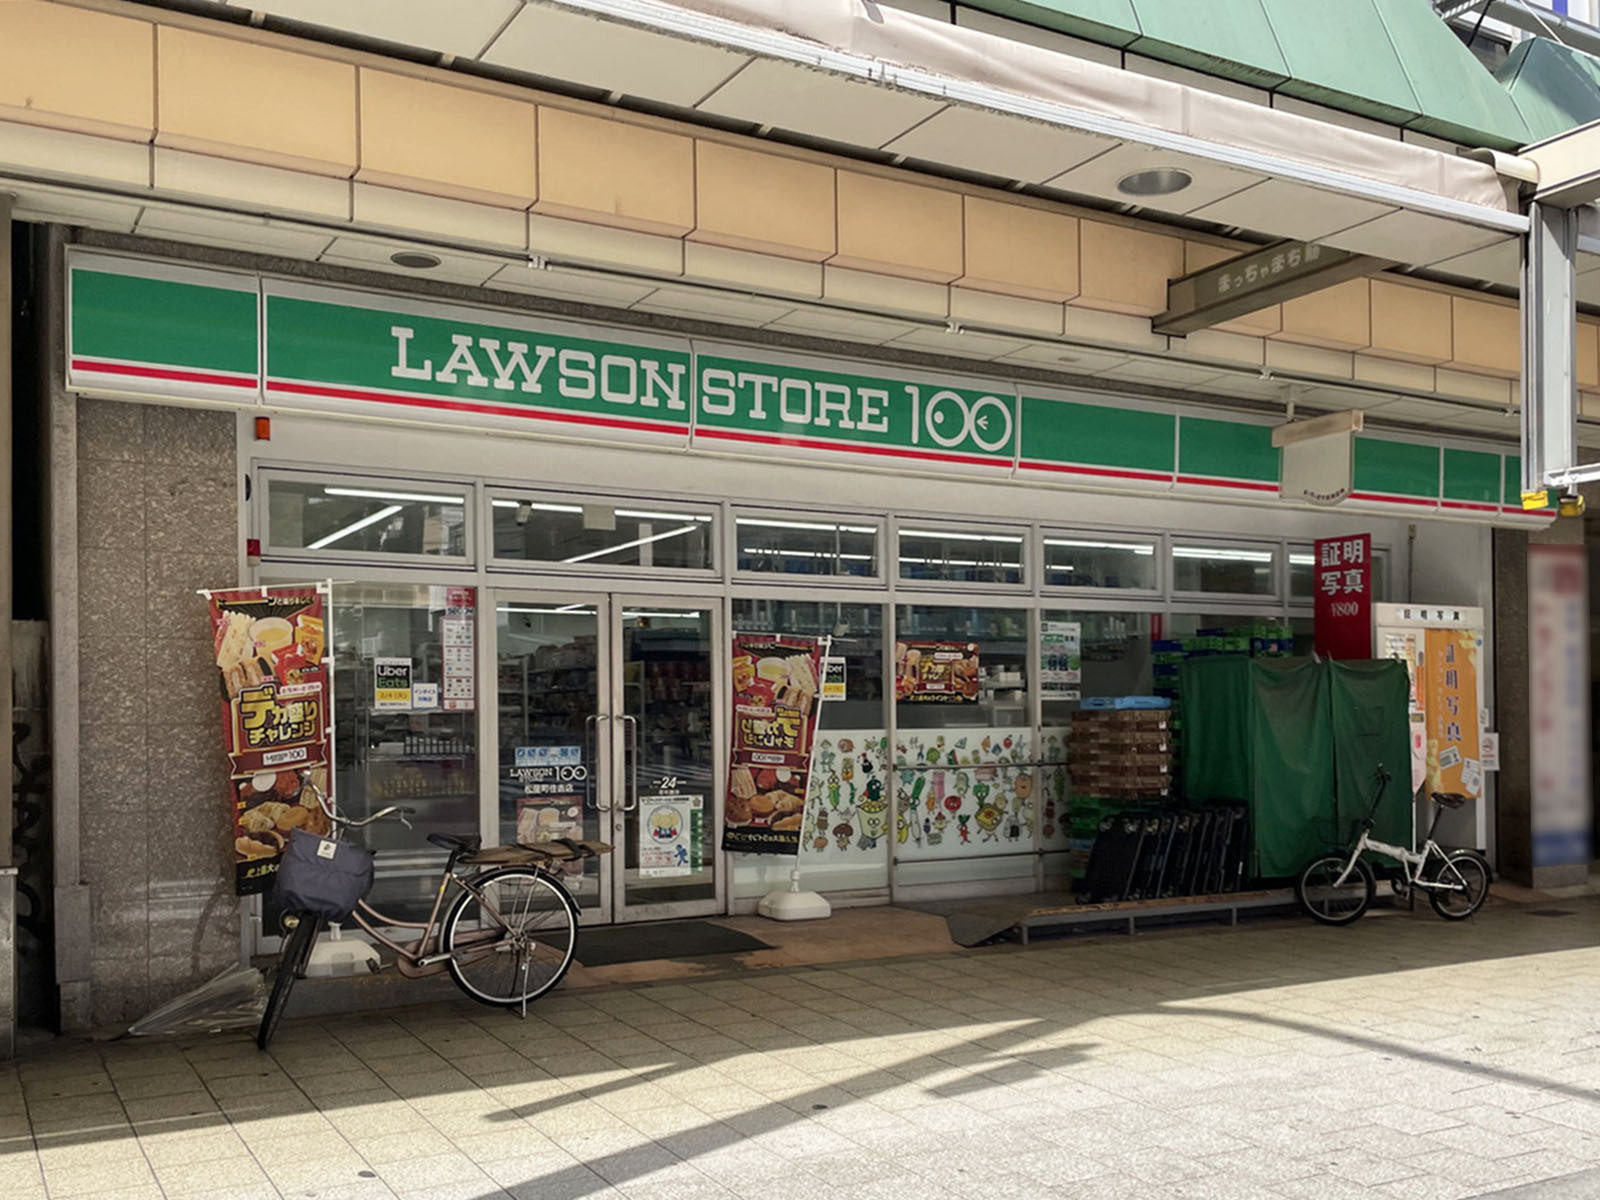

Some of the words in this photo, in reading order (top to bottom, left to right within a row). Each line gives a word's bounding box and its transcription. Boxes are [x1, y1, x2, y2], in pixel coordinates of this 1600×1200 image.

[390, 326, 687, 411] LAWSON
[701, 368, 890, 435] STORE
[903, 384, 1013, 453] 100
[1320, 538, 1364, 568] 証明
[1320, 569, 1364, 597] 写真
[377, 666, 408, 677] Uber
[822, 664, 843, 674] ber
[378, 677, 408, 688] Eats
[1445, 643, 1462, 742] 証明写真
[241, 686, 318, 729] デカ盛り
[249, 722, 316, 745] チャレンジ
[509, 767, 553, 777] LAWSON
[554, 765, 588, 781] 100
